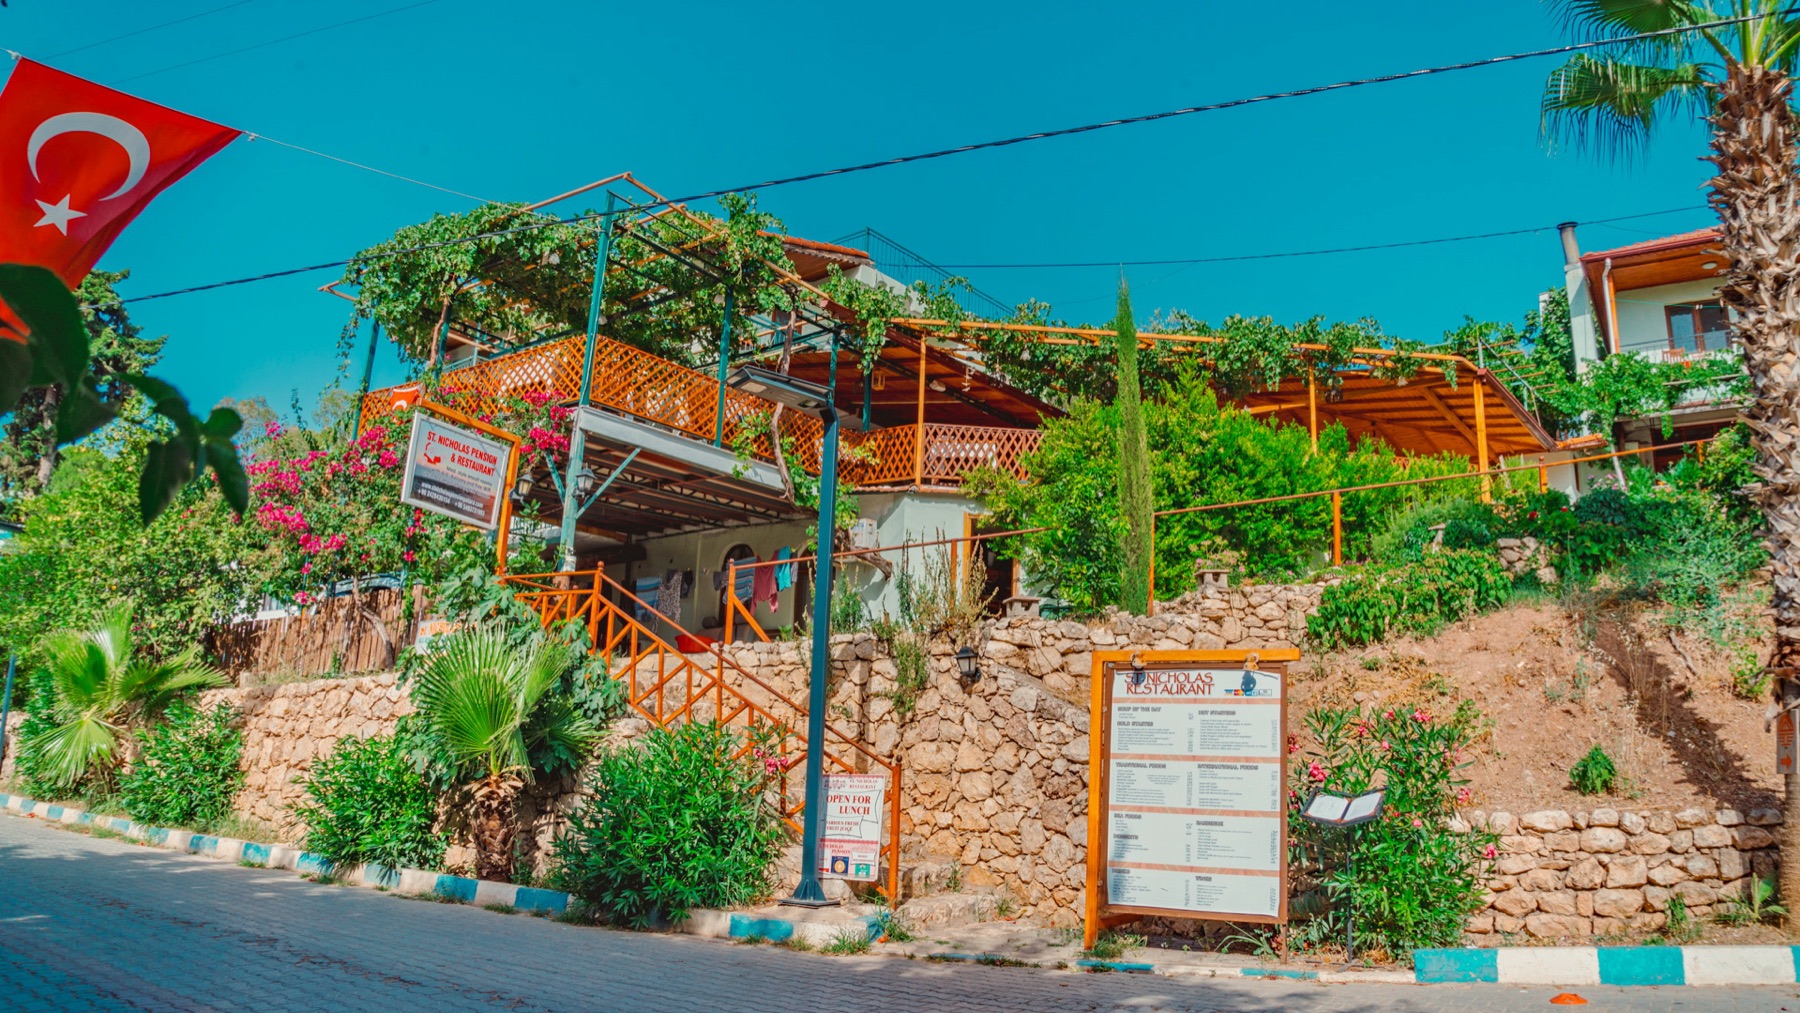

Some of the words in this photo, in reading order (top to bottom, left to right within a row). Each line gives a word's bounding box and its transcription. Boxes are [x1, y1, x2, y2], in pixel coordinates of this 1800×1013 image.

[427, 432, 437, 442] ST.
[438, 436, 470, 455] NICHOLAS
[471, 448, 497, 466] PENSION
[450, 453, 456, 463] &
[457, 455, 495, 477] RESTAURANT
[1146, 672, 1213, 684] NICHOLAS
[1126, 683, 1215, 695] RESTAURANT
[826, 794, 850, 803] OPEN
[852, 795, 871, 804] FOR
[839, 806, 870, 815] LUNCH
